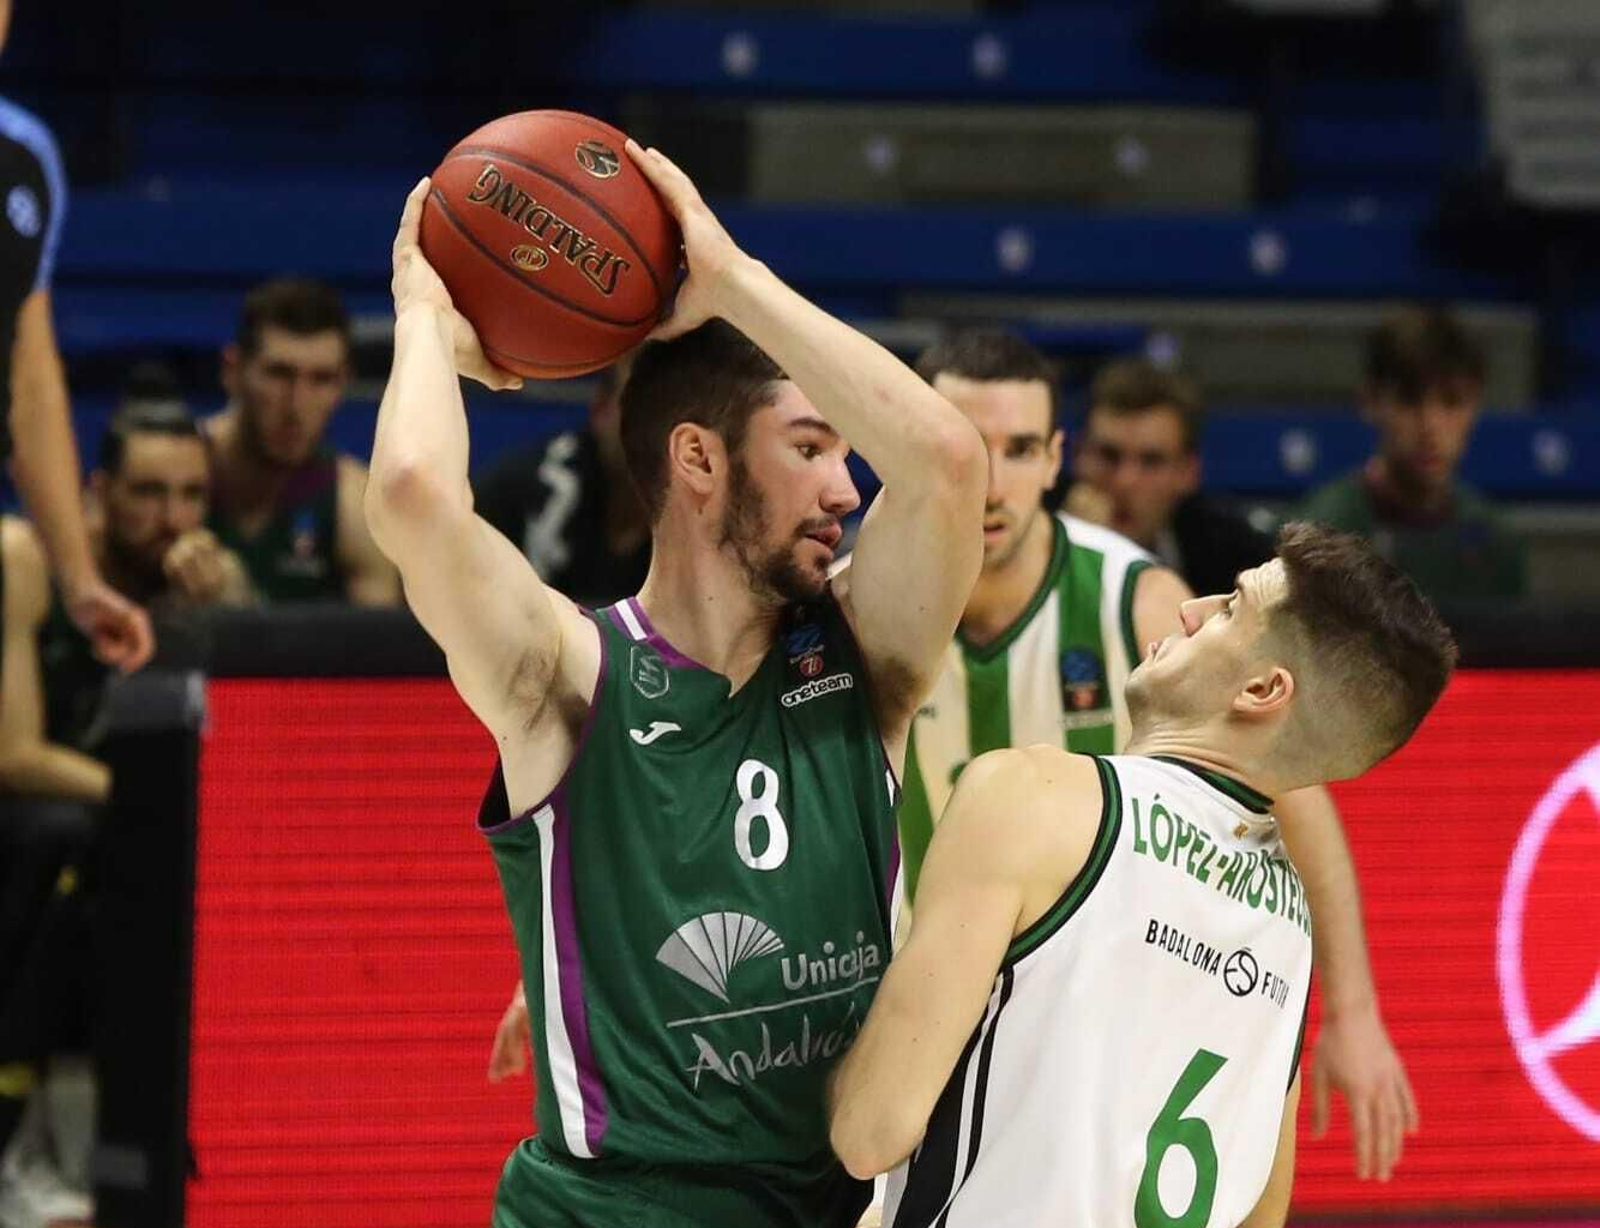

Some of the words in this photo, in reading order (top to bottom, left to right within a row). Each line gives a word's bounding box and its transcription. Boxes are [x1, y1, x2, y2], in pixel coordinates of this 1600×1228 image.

[466, 163, 631, 296] SPALDING
[781, 673, 854, 707] oneteam
[734, 759, 789, 871] 8
[781, 931, 881, 991] Unicaja
[1145, 919, 1223, 977] BADALONA
